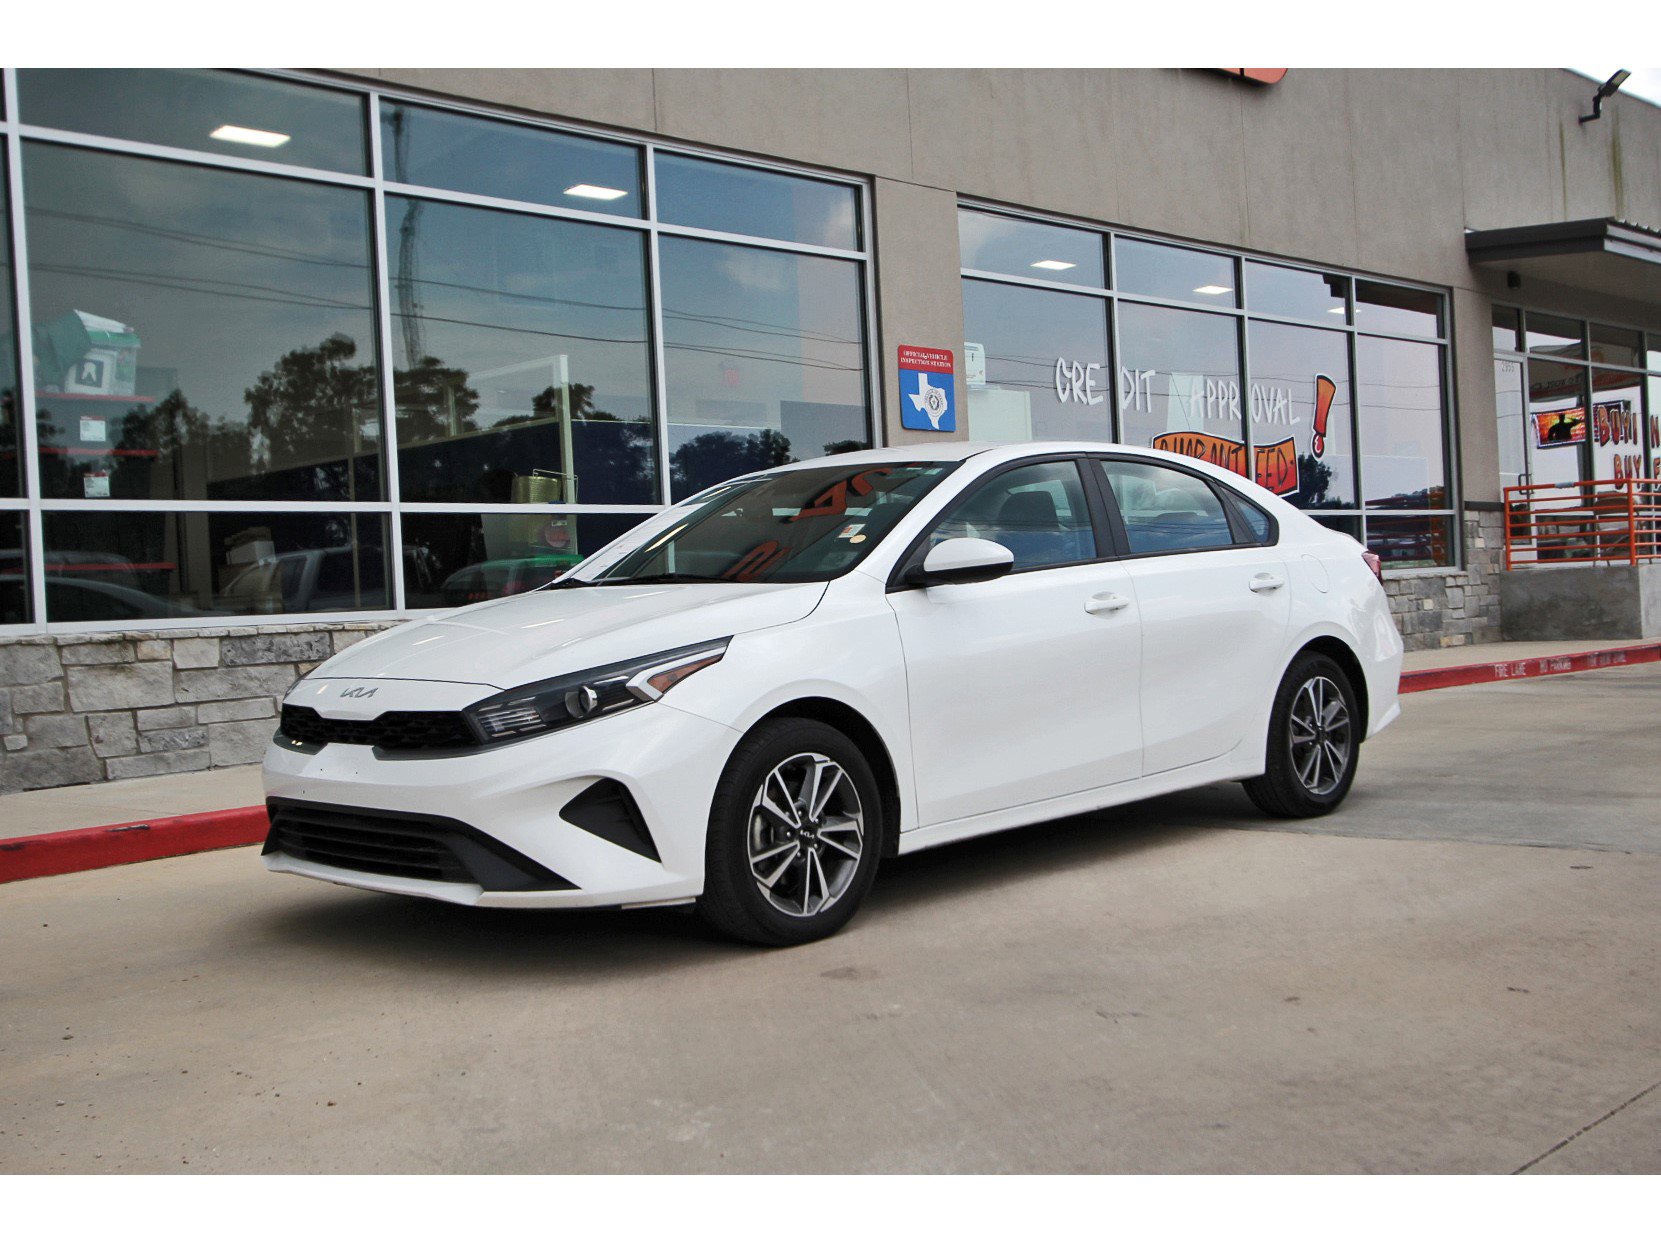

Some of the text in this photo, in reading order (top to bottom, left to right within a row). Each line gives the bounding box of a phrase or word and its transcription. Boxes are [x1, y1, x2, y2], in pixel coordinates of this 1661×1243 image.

[1055, 356, 1156, 413] CREDIT
[1190, 377, 1301, 426] APPROVAL
[1160, 436, 1289, 491] RANTEED
